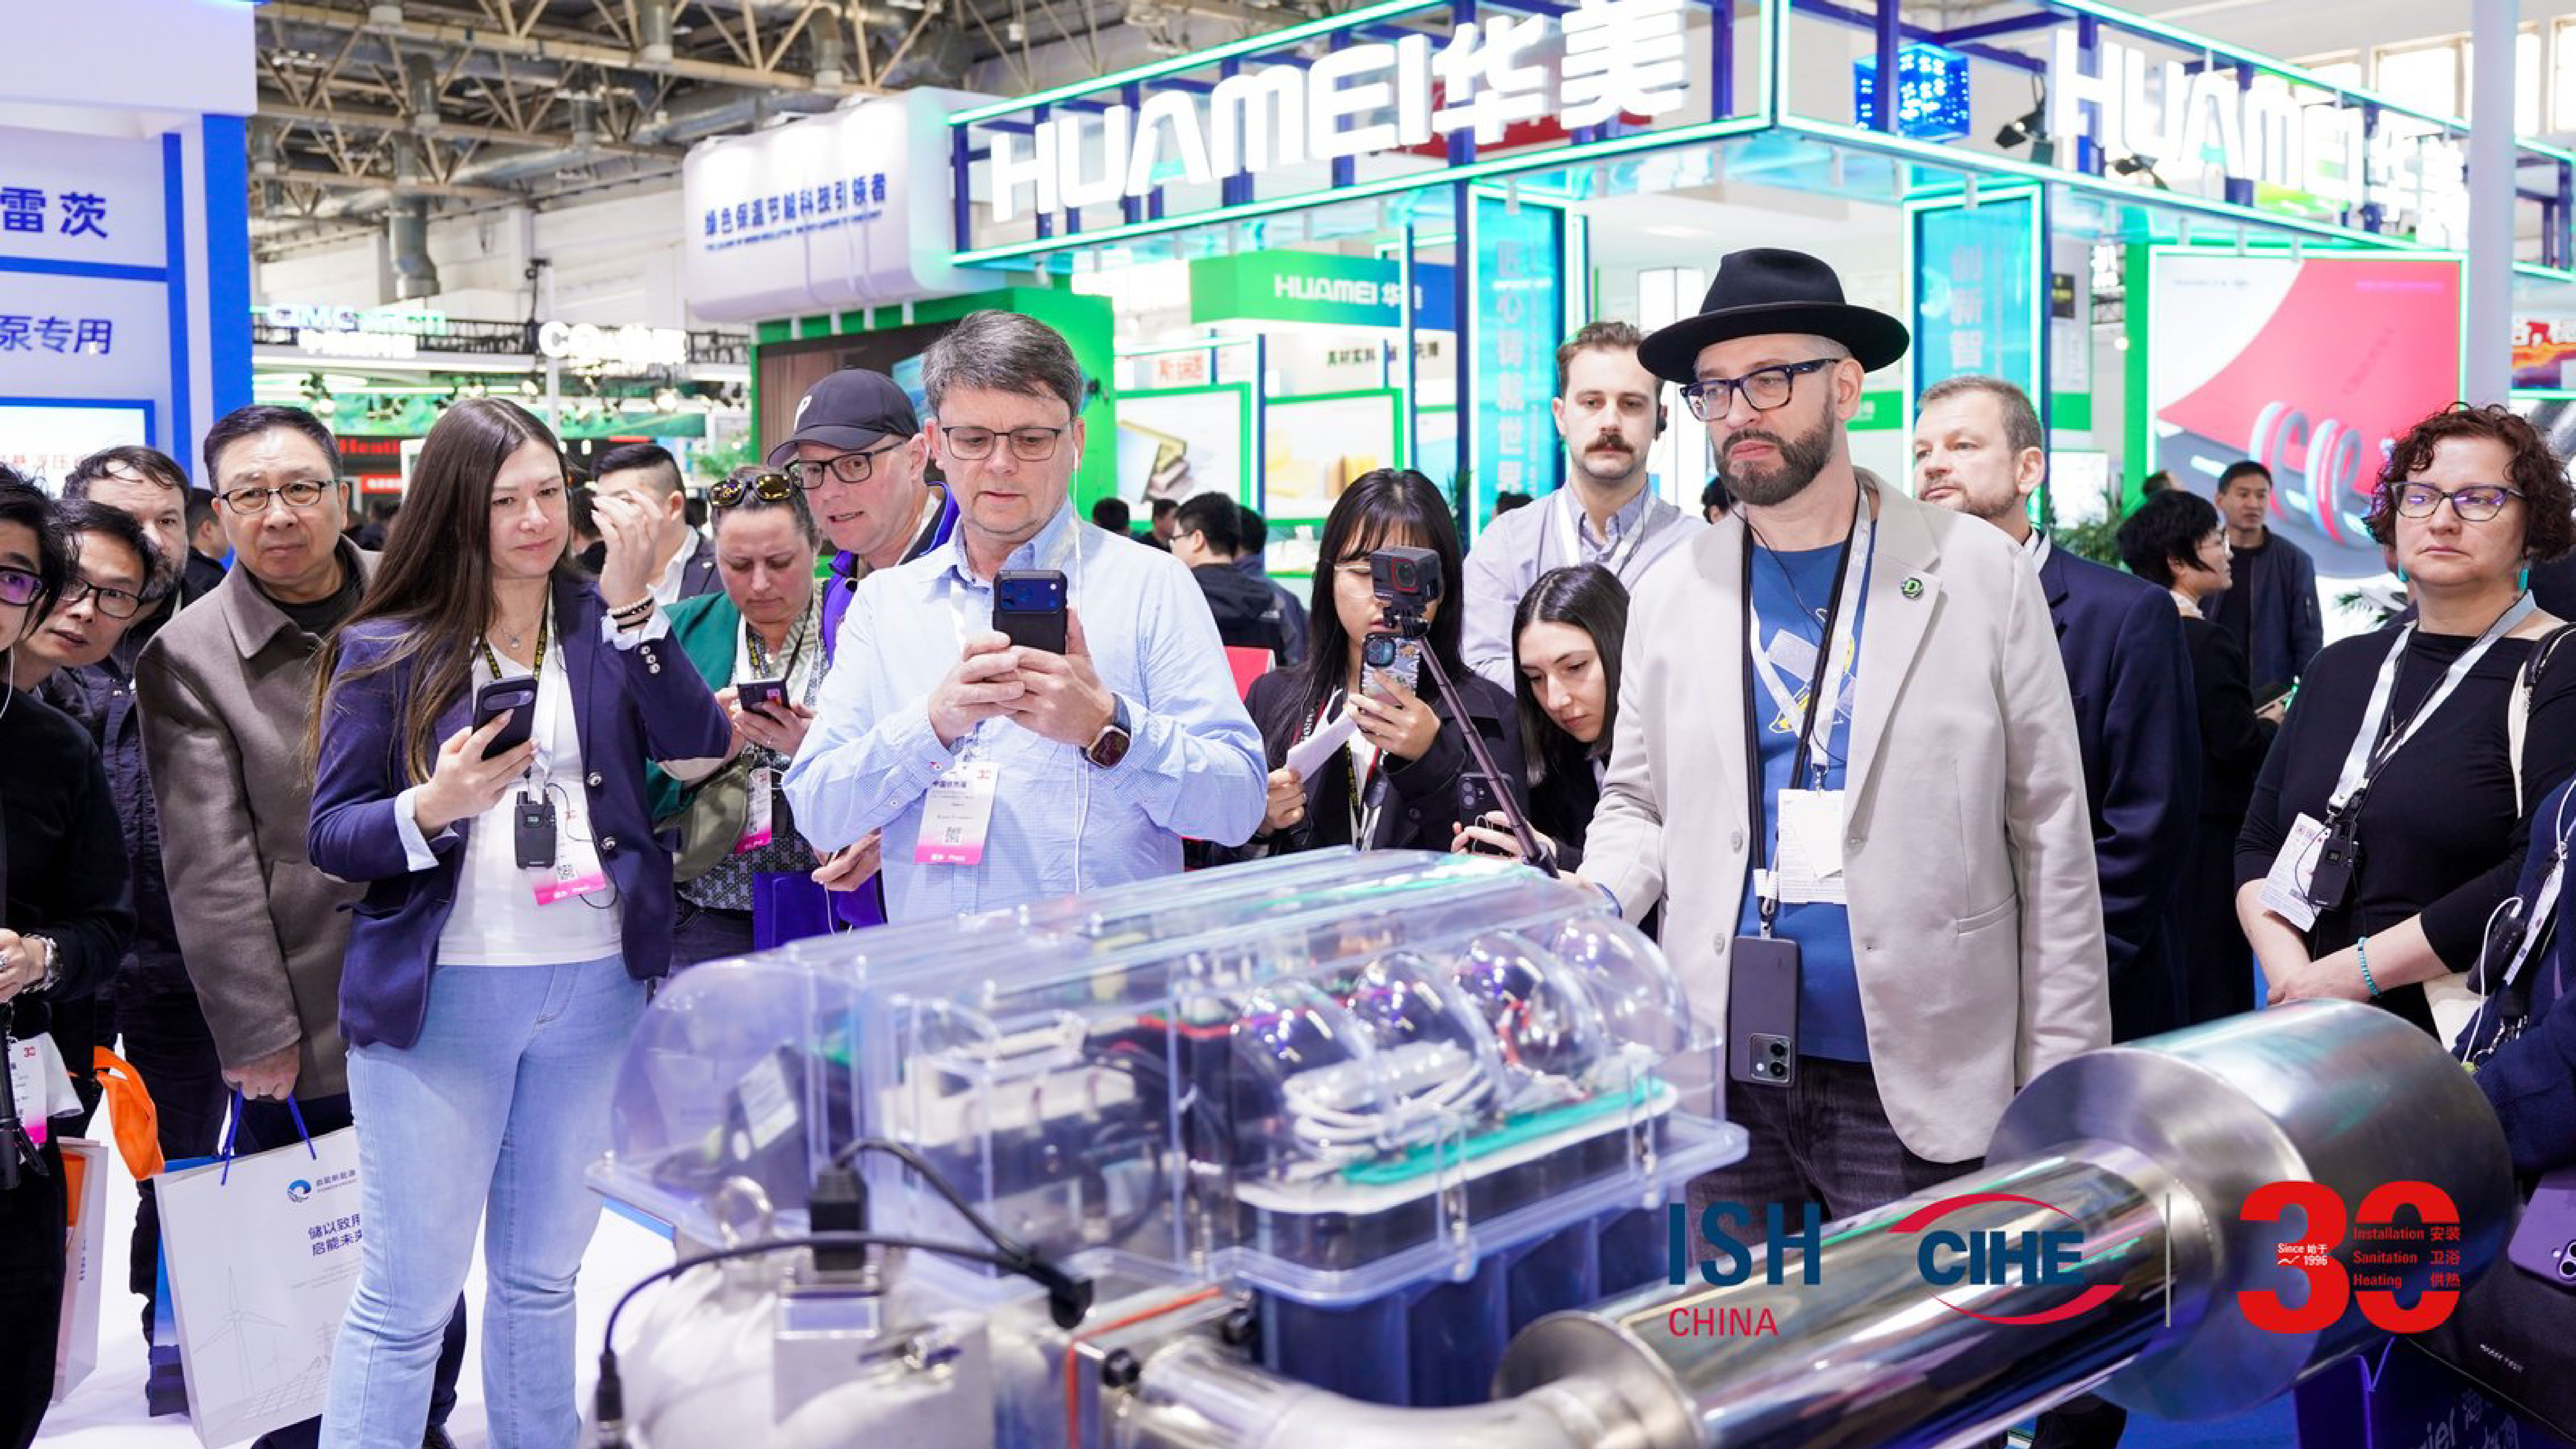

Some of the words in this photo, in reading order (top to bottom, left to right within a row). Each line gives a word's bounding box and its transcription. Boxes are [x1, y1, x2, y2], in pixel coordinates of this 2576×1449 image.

[0, 187, 109, 239] 雷茨
[1274, 275, 1377, 305] HUAMEI
[0, 315, 112, 354] 泵专用
